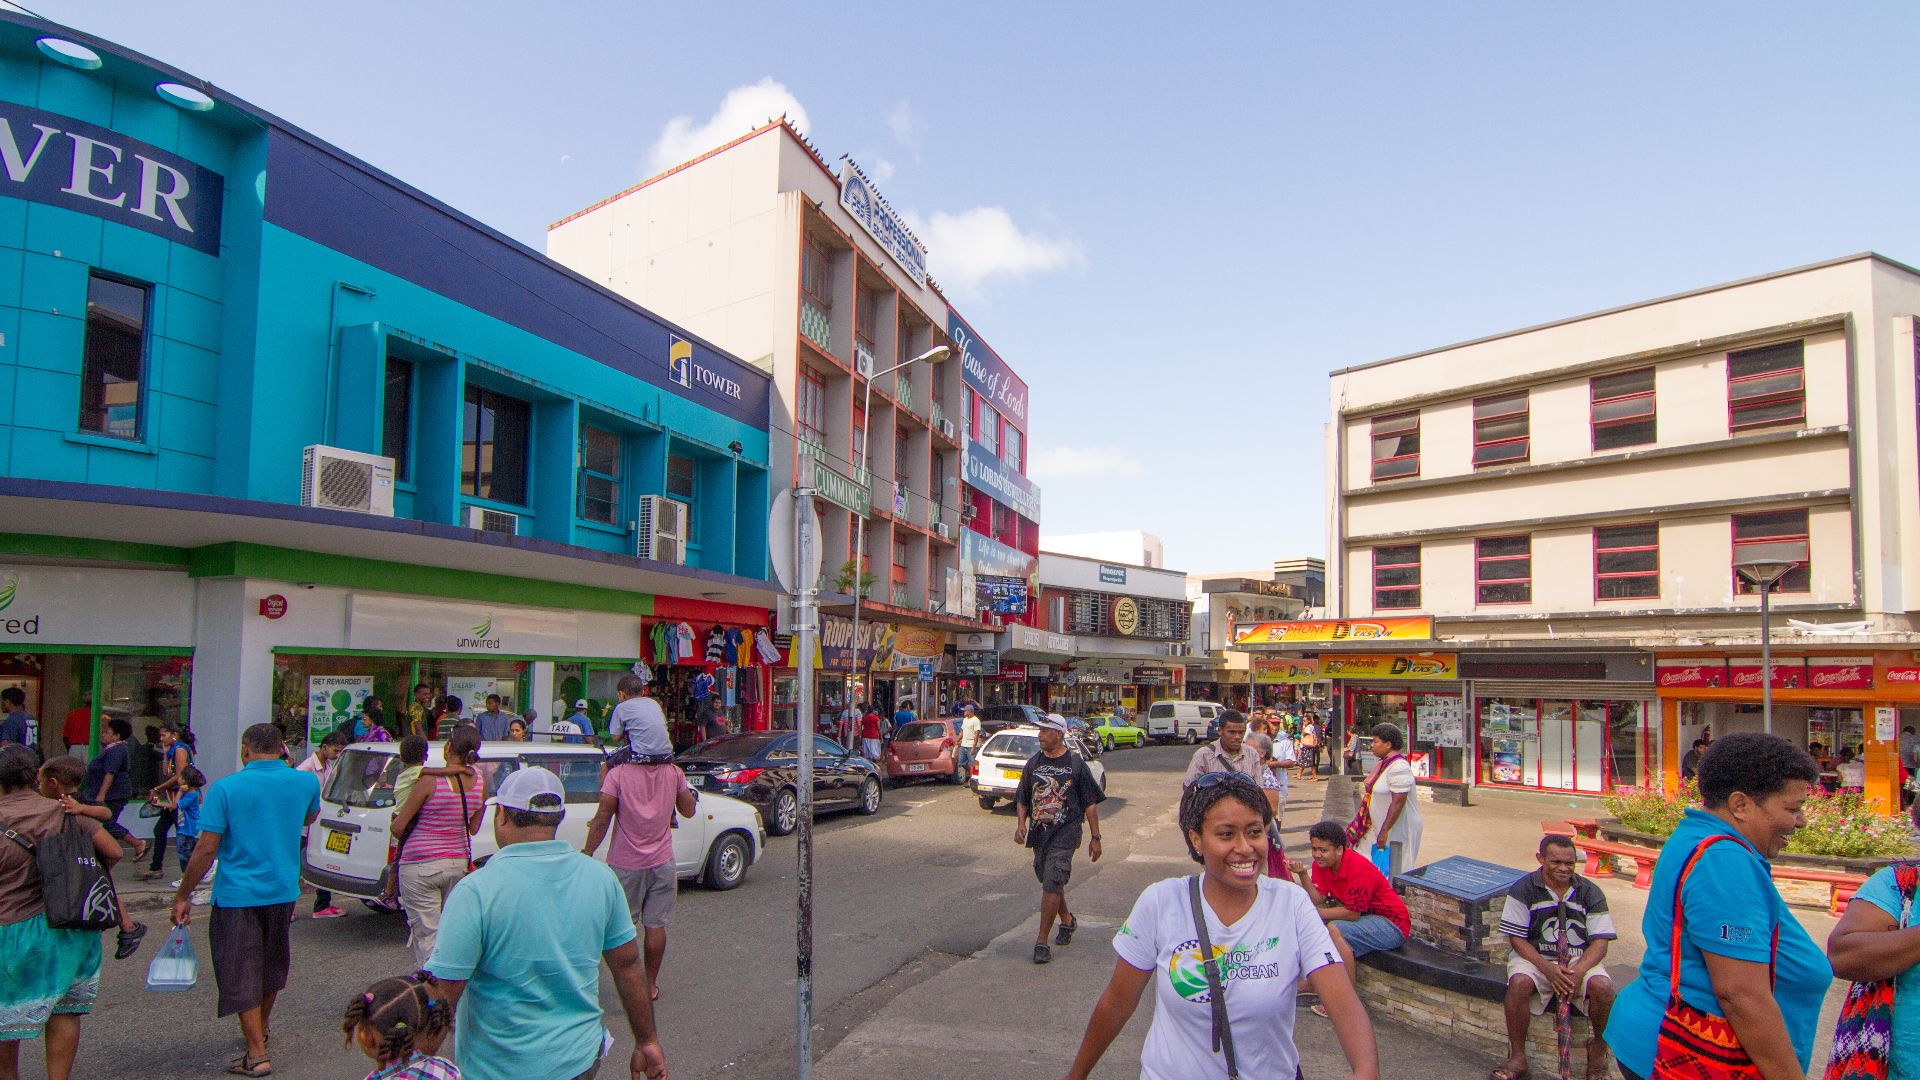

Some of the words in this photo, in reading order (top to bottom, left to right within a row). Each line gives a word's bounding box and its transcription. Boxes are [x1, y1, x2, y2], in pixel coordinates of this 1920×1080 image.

[873, 200, 924, 271] PROFESSIONAL
[693, 363, 741, 400] TOWER
[955, 327, 987, 384] House
[987, 372, 1000, 399] of
[998, 376, 1025, 419] Lords
[815, 466, 861, 511] CUMMING
[863, 491, 869, 504] ST
[822, 620, 871, 650] ROOPSH
[1287, 624, 1328, 634] PHONE
[457, 638, 500, 649] unwired
[1342, 659, 1379, 668] PHONE
[1661, 667, 1702, 686] Coca-Cola
[1734, 667, 1778, 686] Coca-Cla
[1813, 666, 1861, 687] Coca-Cola
[1887, 670, 1917, 681] Coca-Cola
[551, 724, 571, 733] TAXI
[1538, 943, 1558, 952] NEW
[1226, 962, 1280, 980] OCEAN
